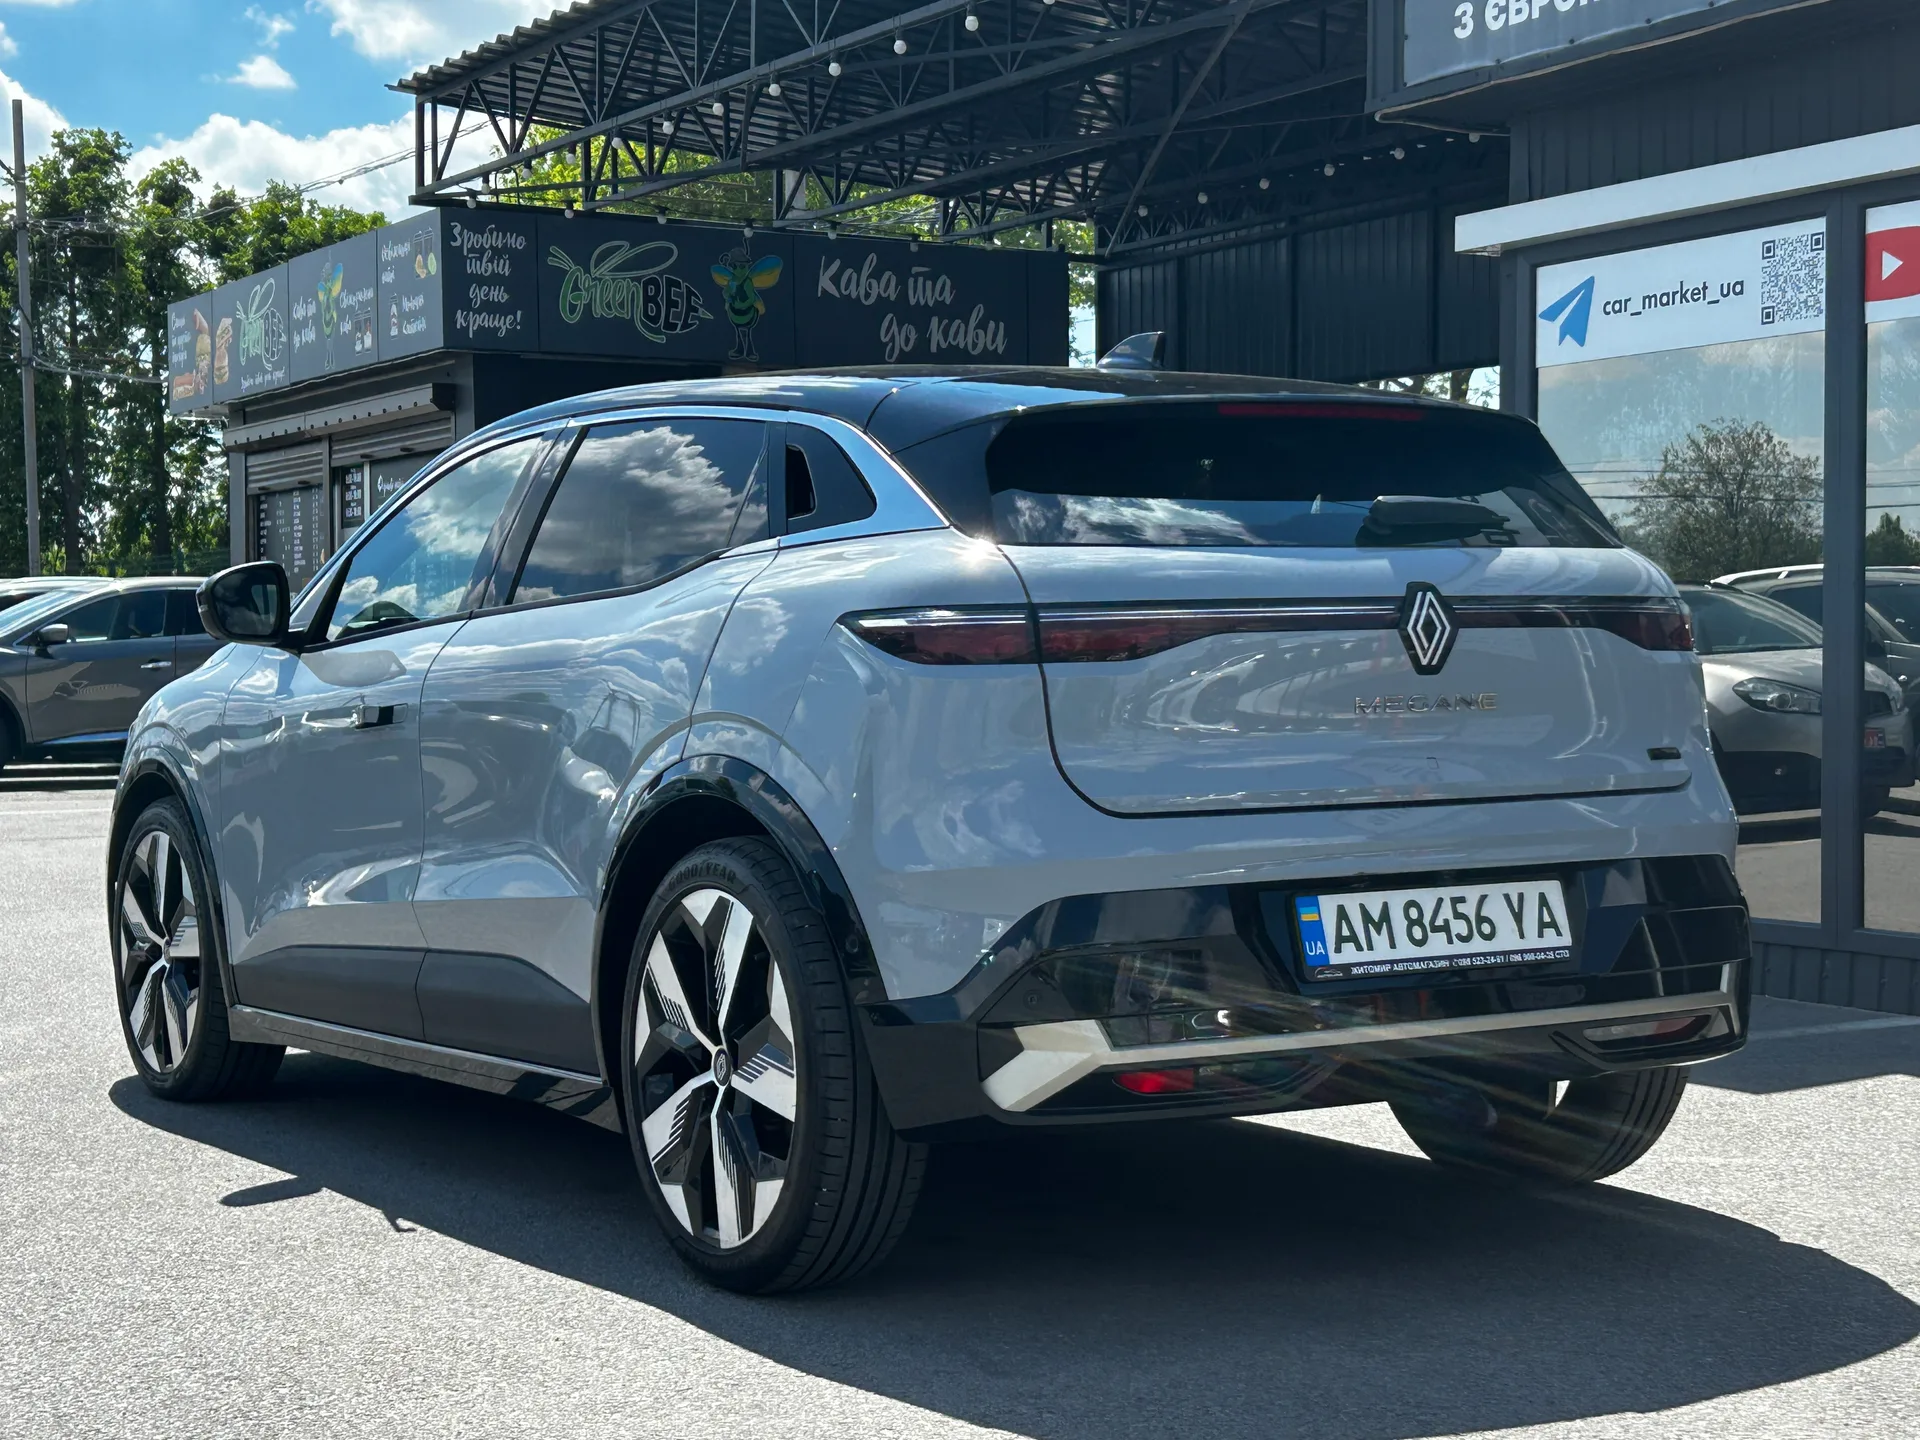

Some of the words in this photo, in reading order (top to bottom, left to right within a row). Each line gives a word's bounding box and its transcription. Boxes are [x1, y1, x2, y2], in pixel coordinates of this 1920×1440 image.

[1453, 2, 1474, 39] З
[450, 222, 526, 256] Зробимо
[466, 249, 511, 276] твій
[817, 252, 901, 306] Кава
[908, 266, 956, 307] та
[469, 283, 509, 308] день
[1602, 279, 1745, 317] car_market_ua
[455, 310, 522, 338] краще!
[880, 313, 918, 363] до
[927, 303, 1008, 355] кави
[1354, 693, 1498, 715] MEGANE
[1334, 901, 1397, 954] AM
[1403, 894, 1496, 948] 8456
[1503, 892, 1563, 940] YA
[1305, 941, 1326, 956] UA
[1350, 964, 1391, 975] ЖИТОМИР
